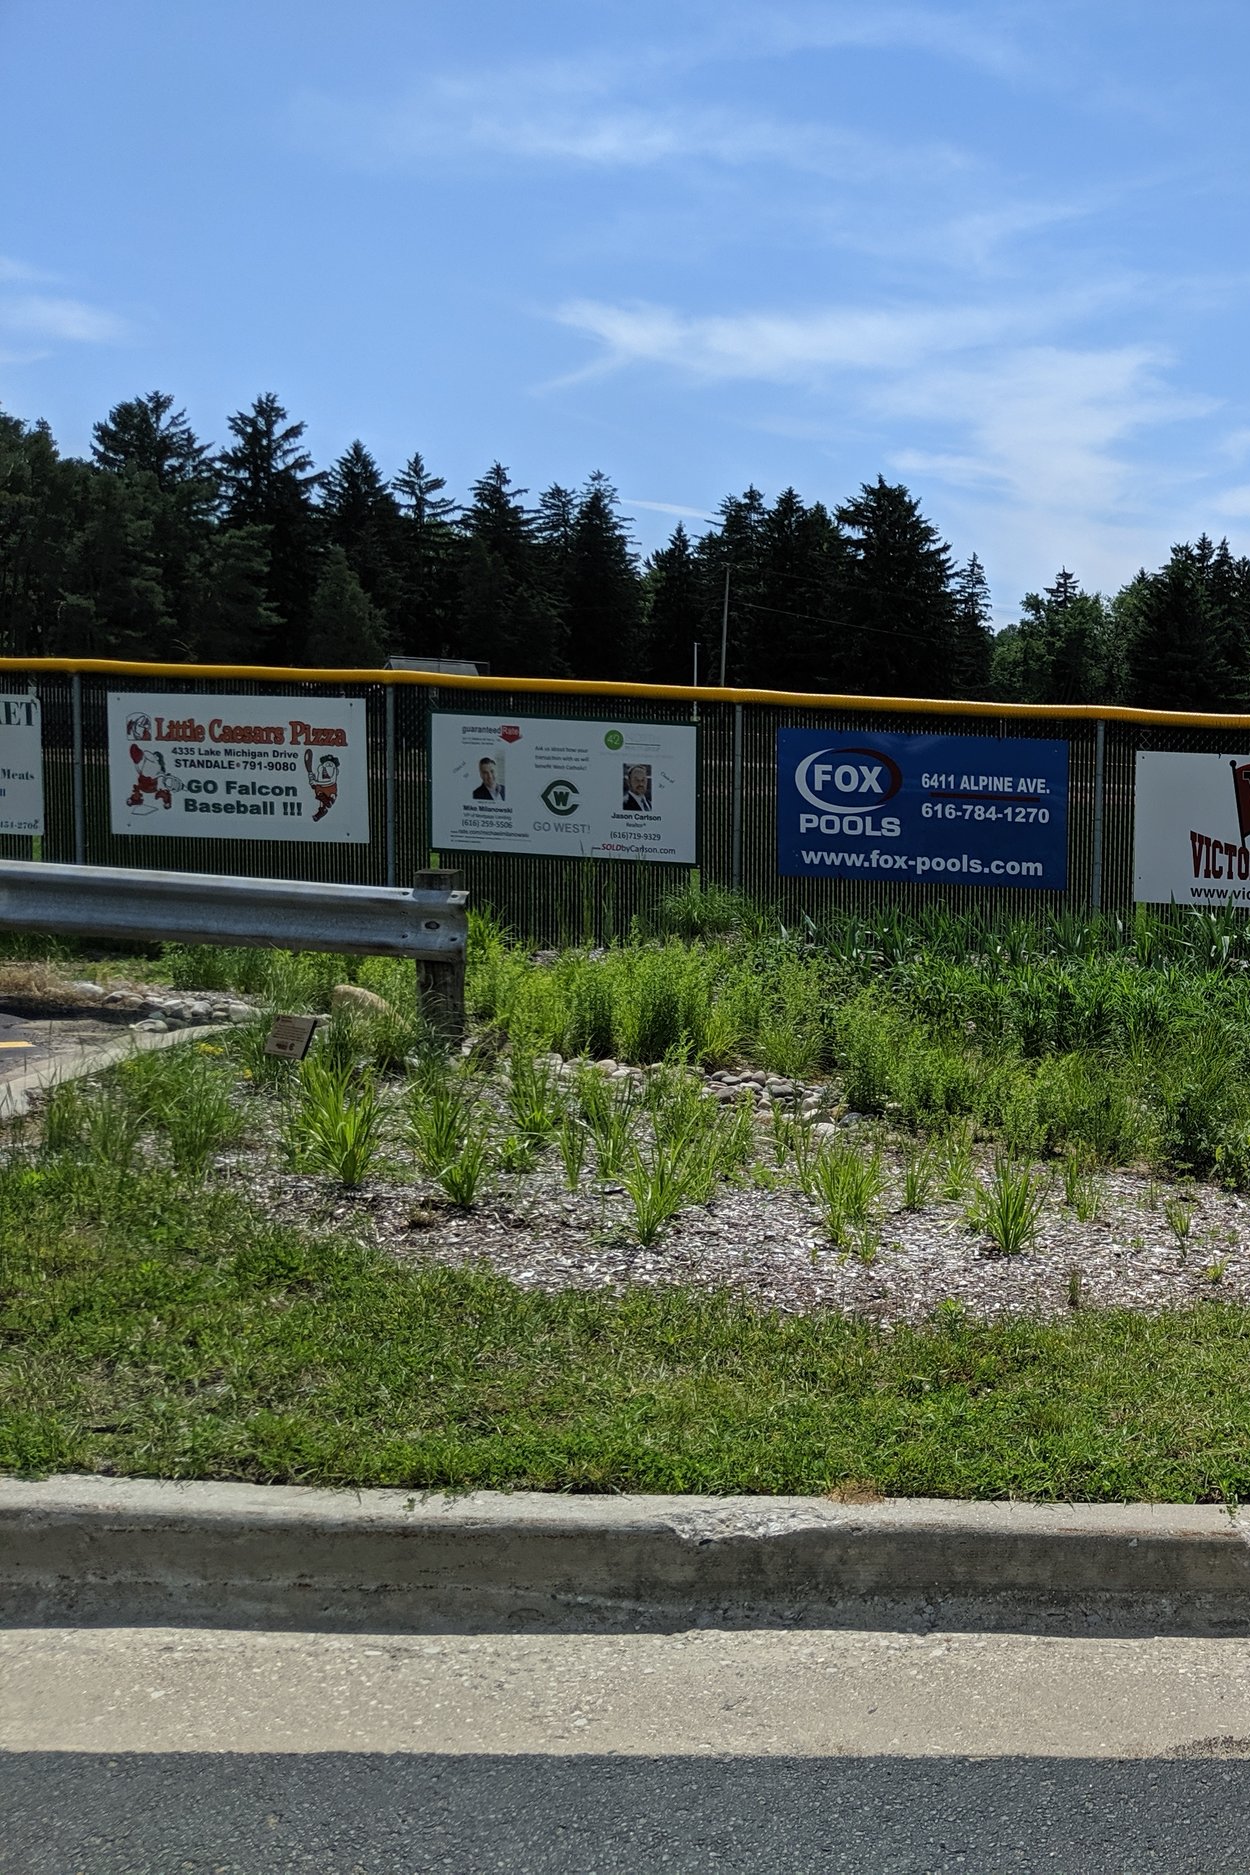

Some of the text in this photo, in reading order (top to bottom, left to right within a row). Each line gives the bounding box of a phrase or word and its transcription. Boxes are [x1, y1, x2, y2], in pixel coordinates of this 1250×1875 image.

[0, 701, 38, 726] ET
[155, 717, 348, 747] Little Caesars Pizza
[171, 747, 299, 760] 4335 Lake Michigan Drive
[187, 779, 298, 797] GO Falcon
[813, 764, 884, 794] FOX
[921, 773, 1051, 794] 6411 ALPINE AVE.
[184, 799, 275, 816] Baseball
[611, 812, 662, 822] Jason Carlson
[921, 802, 1050, 824] 616-784-1270
[462, 819, 480, 828] (616)
[533, 821, 591, 835] GO WEST!
[799, 813, 901, 837] POOLS
[801, 849, 1043, 876] www.fox-pools.com
